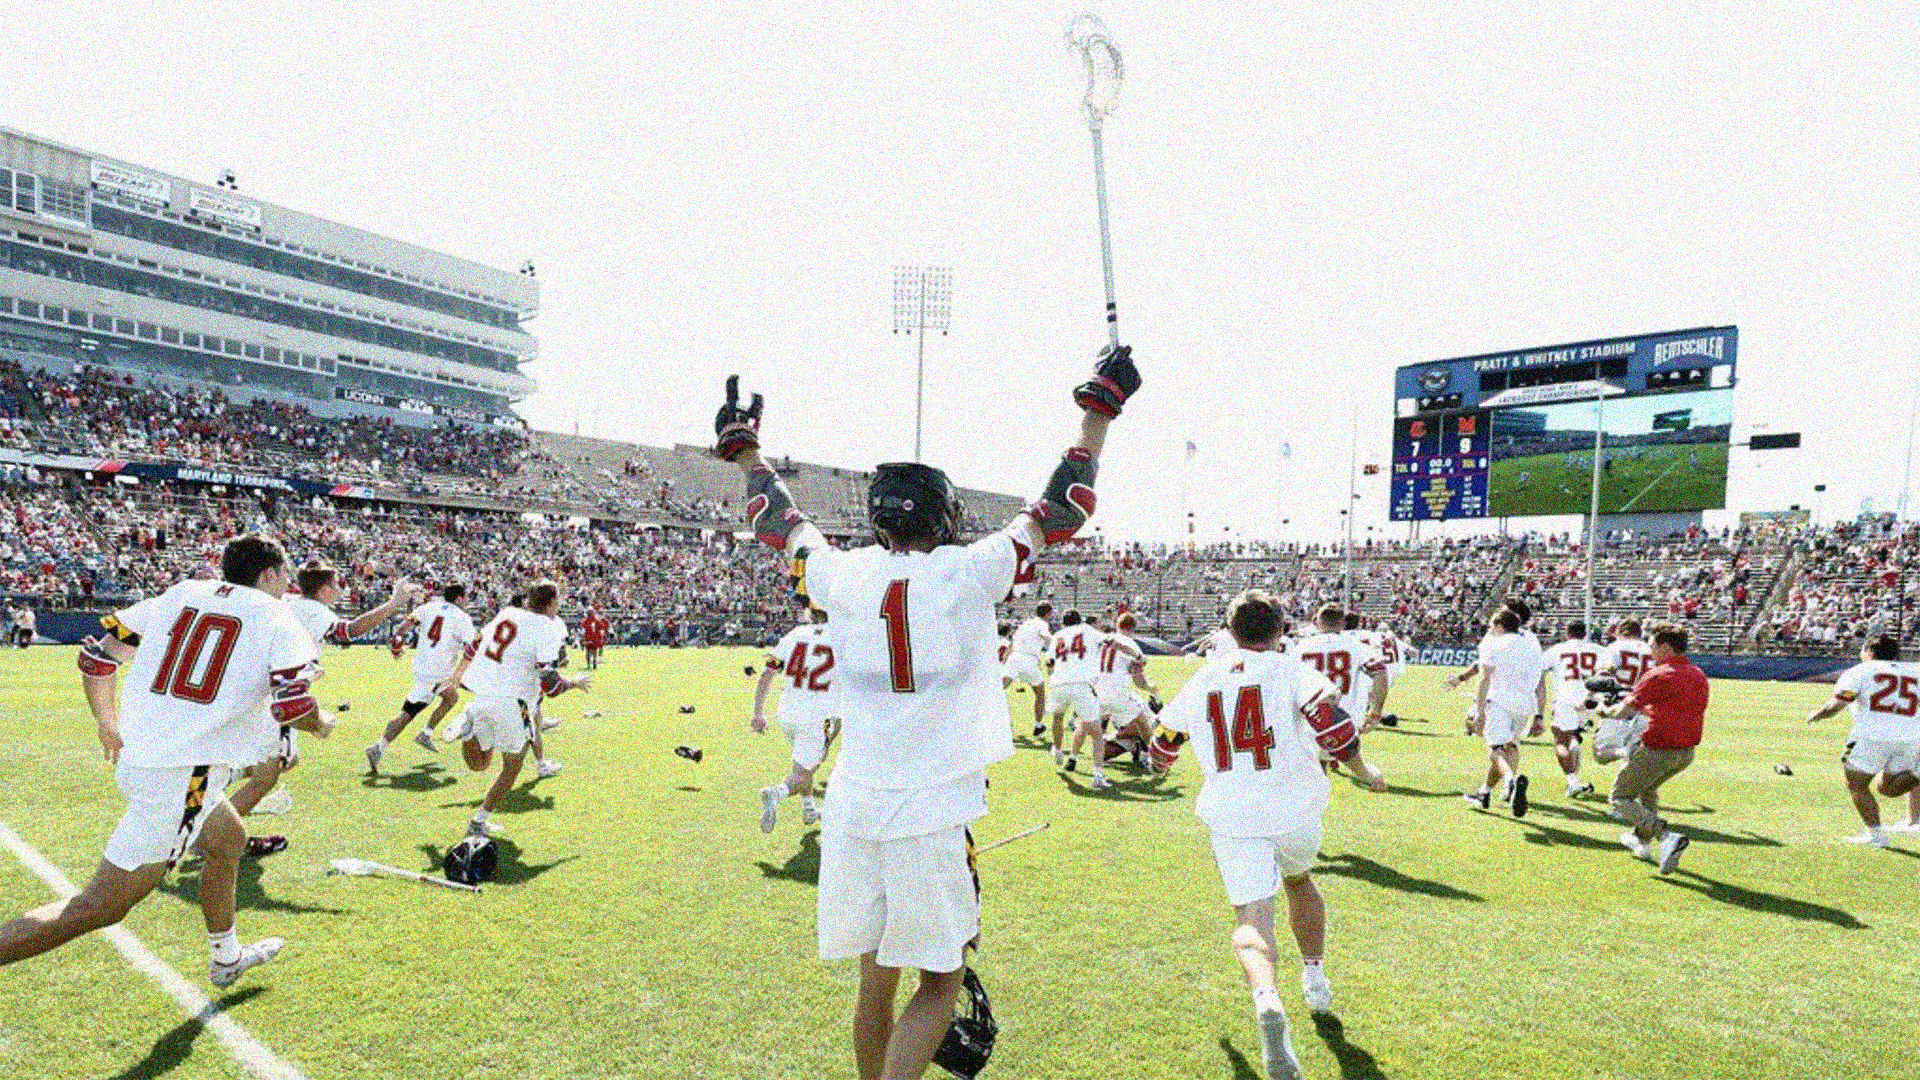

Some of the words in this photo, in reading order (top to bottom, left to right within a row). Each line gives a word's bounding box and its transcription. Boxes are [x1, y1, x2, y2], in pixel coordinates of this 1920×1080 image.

[1474, 357, 1509, 371] PRATT
[1512, 356, 1521, 368] &
[1525, 350, 1577, 365] WHITNEY
[1580, 342, 1636, 359] STADIUM
[1411, 441, 1420, 457] 7
[1460, 437, 1471, 454] 9
[177, 468, 232, 484] MARYLAND
[427, 615, 445, 648] 4
[485, 620, 518, 664] 9
[880, 578, 915, 693] 1
[1056, 633, 1087, 661] 44
[150, 605, 243, 705] 10
[786, 642, 835, 692] 42
[1560, 652, 1597, 681] 39
[1870, 673, 1918, 718] 25
[1206, 684, 1276, 773] 14
